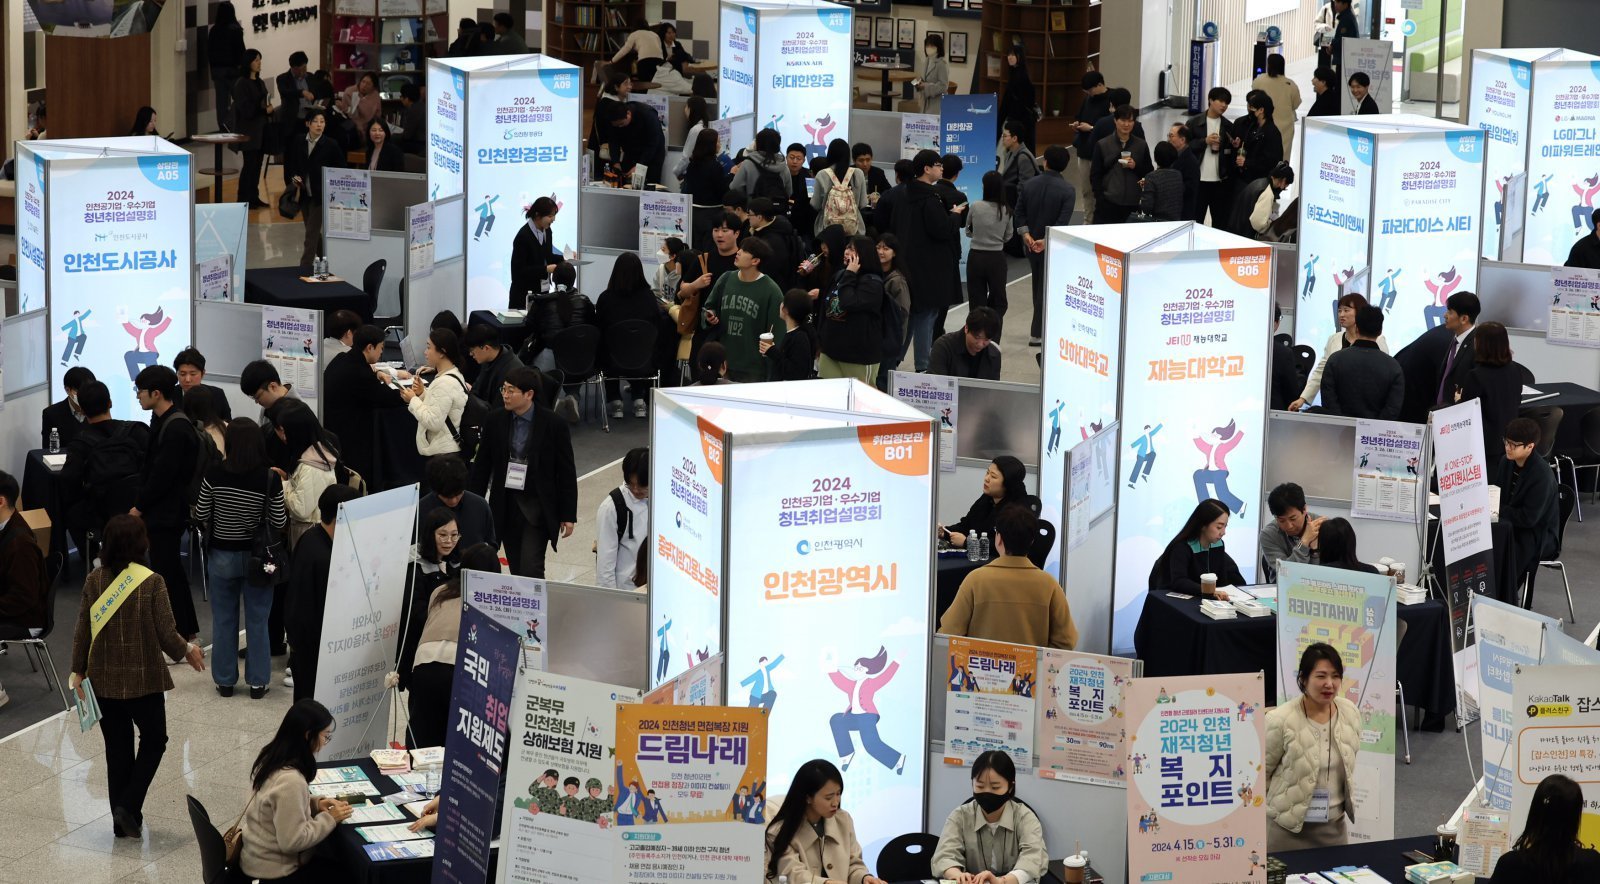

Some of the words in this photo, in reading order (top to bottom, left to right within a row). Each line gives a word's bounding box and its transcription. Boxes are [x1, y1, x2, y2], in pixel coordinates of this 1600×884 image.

[554, 80, 571, 89] A09
[772, 74, 834, 89] (주)대한항공
[1569, 85, 1587, 93] 2024
[514, 97, 535, 106] 2024
[495, 113, 553, 124] 청년취업설명회
[946, 122, 973, 132] 대한항공
[1553, 128, 1596, 141] LG마그나
[946, 134, 960, 143] 꿈의
[478, 146, 568, 164] 인천환경공단
[1458, 144, 1474, 153] A21
[1332, 154, 1346, 165] 2024
[1420, 161, 1440, 170] 2024
[157, 170, 179, 180] A05
[1401, 179, 1457, 190] 청년취업설명회
[107, 190, 135, 200] 2024
[86, 202, 122, 211] 인천공기업
[126, 201, 156, 210] 우수기업
[84, 210, 157, 223] 청년취업설명회
[1307, 203, 1365, 234] (주)포스코이앤씨
[1382, 217, 1444, 234] 파라다이스
[1446, 216, 1472, 231] 시티
[64, 249, 178, 273] 인천도시공사
[1237, 265, 1260, 277] B06
[1078, 276, 1094, 290] 2024
[1185, 288, 1214, 300] 2024
[721, 294, 760, 319] CLASSES
[1064, 294, 1105, 320] 청년취업설명회
[1163, 302, 1200, 312] 인천공기업
[1204, 300, 1234, 310] 우수기업
[1160, 310, 1235, 326] 청년취업설명회
[266, 320, 314, 333] 청년취업설명회
[1194, 333, 1228, 344] 재능대학교
[1059, 337, 1110, 377] 인하대학교
[1148, 355, 1244, 382] 재능대학교
[898, 388, 953, 402] 청년취업설명회
[872, 432, 924, 446] 취업정보관
[1360, 435, 1420, 450] 청년취업설명회
[884, 445, 913, 461] B01
[682, 456, 697, 476] 2024
[812, 477, 852, 493] 2024
[1440, 464, 1482, 492] 취업지원시스템
[670, 478, 708, 517] 청년취업설명회
[781, 494, 833, 510] 인천공기업
[840, 491, 881, 505] 우수기업
[778, 504, 882, 527] 청년취업설명회
[814, 538, 864, 552] 인천광역시
[658, 534, 719, 598] 중부지방고용노동청
[764, 562, 898, 601] 인천광역시
[474, 592, 540, 610] 청년취업설명회
[463, 648, 491, 688] 국민
[968, 656, 1016, 675] 드림나래
[1070, 668, 1088, 677] 2024
[1090, 670, 1105, 680] 인천
[1070, 676, 1105, 689] 재직청년
[1068, 685, 1080, 698] 복
[1092, 688, 1104, 701] 지
[1528, 694, 1570, 704] KakaoTalk
[526, 694, 565, 716] 군복무
[1068, 698, 1104, 714] 포인트
[1540, 706, 1570, 714] 플러스친구
[485, 693, 509, 733] 취업
[525, 713, 576, 737] 인천청년
[638, 720, 660, 730] 2024
[662, 720, 696, 732] 인천청년
[697, 721, 731, 732] 면접복장
[732, 722, 749, 733] 지원
[1160, 718, 1198, 734] 2024
[1202, 716, 1232, 732] 인천
[456, 706, 506, 764] 지원제도
[523, 730, 574, 755] 상해보험
[576, 742, 603, 760] 지원
[637, 735, 747, 766] 드림나래
[1160, 733, 1232, 754] 재직청년
[1531, 750, 1577, 760] [잡스인천]의
[1160, 755, 1183, 781] 복
[1208, 753, 1232, 778] 지
[671, 772, 683, 780] 인천
[684, 772, 712, 781] 청년이라면
[652, 780, 670, 789] 면접용
[671, 781, 690, 790] 정장과
[690, 782, 708, 790] 이미지
[708, 782, 731, 790] 컨설팅이
[1160, 780, 1234, 808] 포인트
